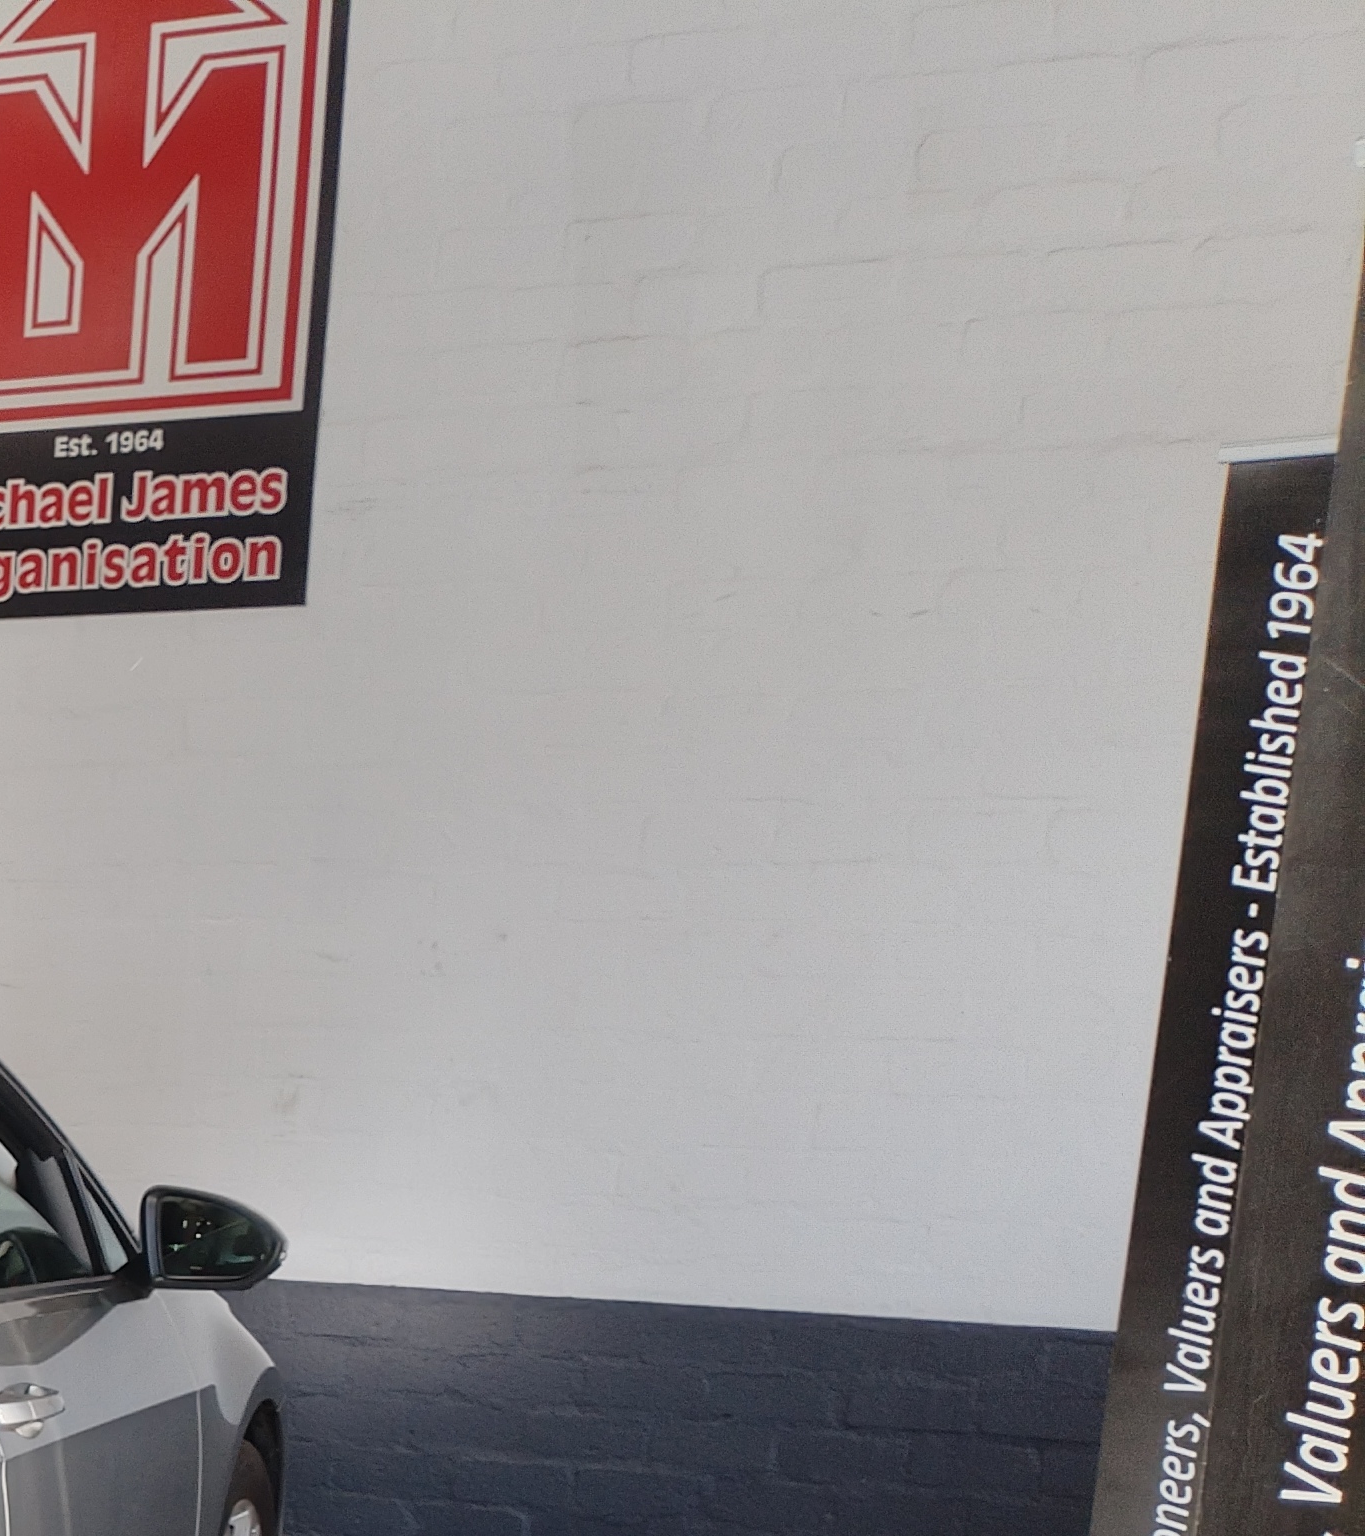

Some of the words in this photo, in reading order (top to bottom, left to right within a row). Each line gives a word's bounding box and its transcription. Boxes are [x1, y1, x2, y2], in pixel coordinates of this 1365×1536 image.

[53, 435, 98, 458] Est.
[105, 428, 164, 454] 1964
[120, 468, 288, 523] James
[1267, 533, 1324, 639] 1964
[1232, 650, 1308, 892] Established
[1198, 929, 1269, 1150] Appraisers
[1192, 1153, 1238, 1236] and
[1163, 1245, 1225, 1392] Valuers
[1280, 1297, 1365, 1504] Valuers
